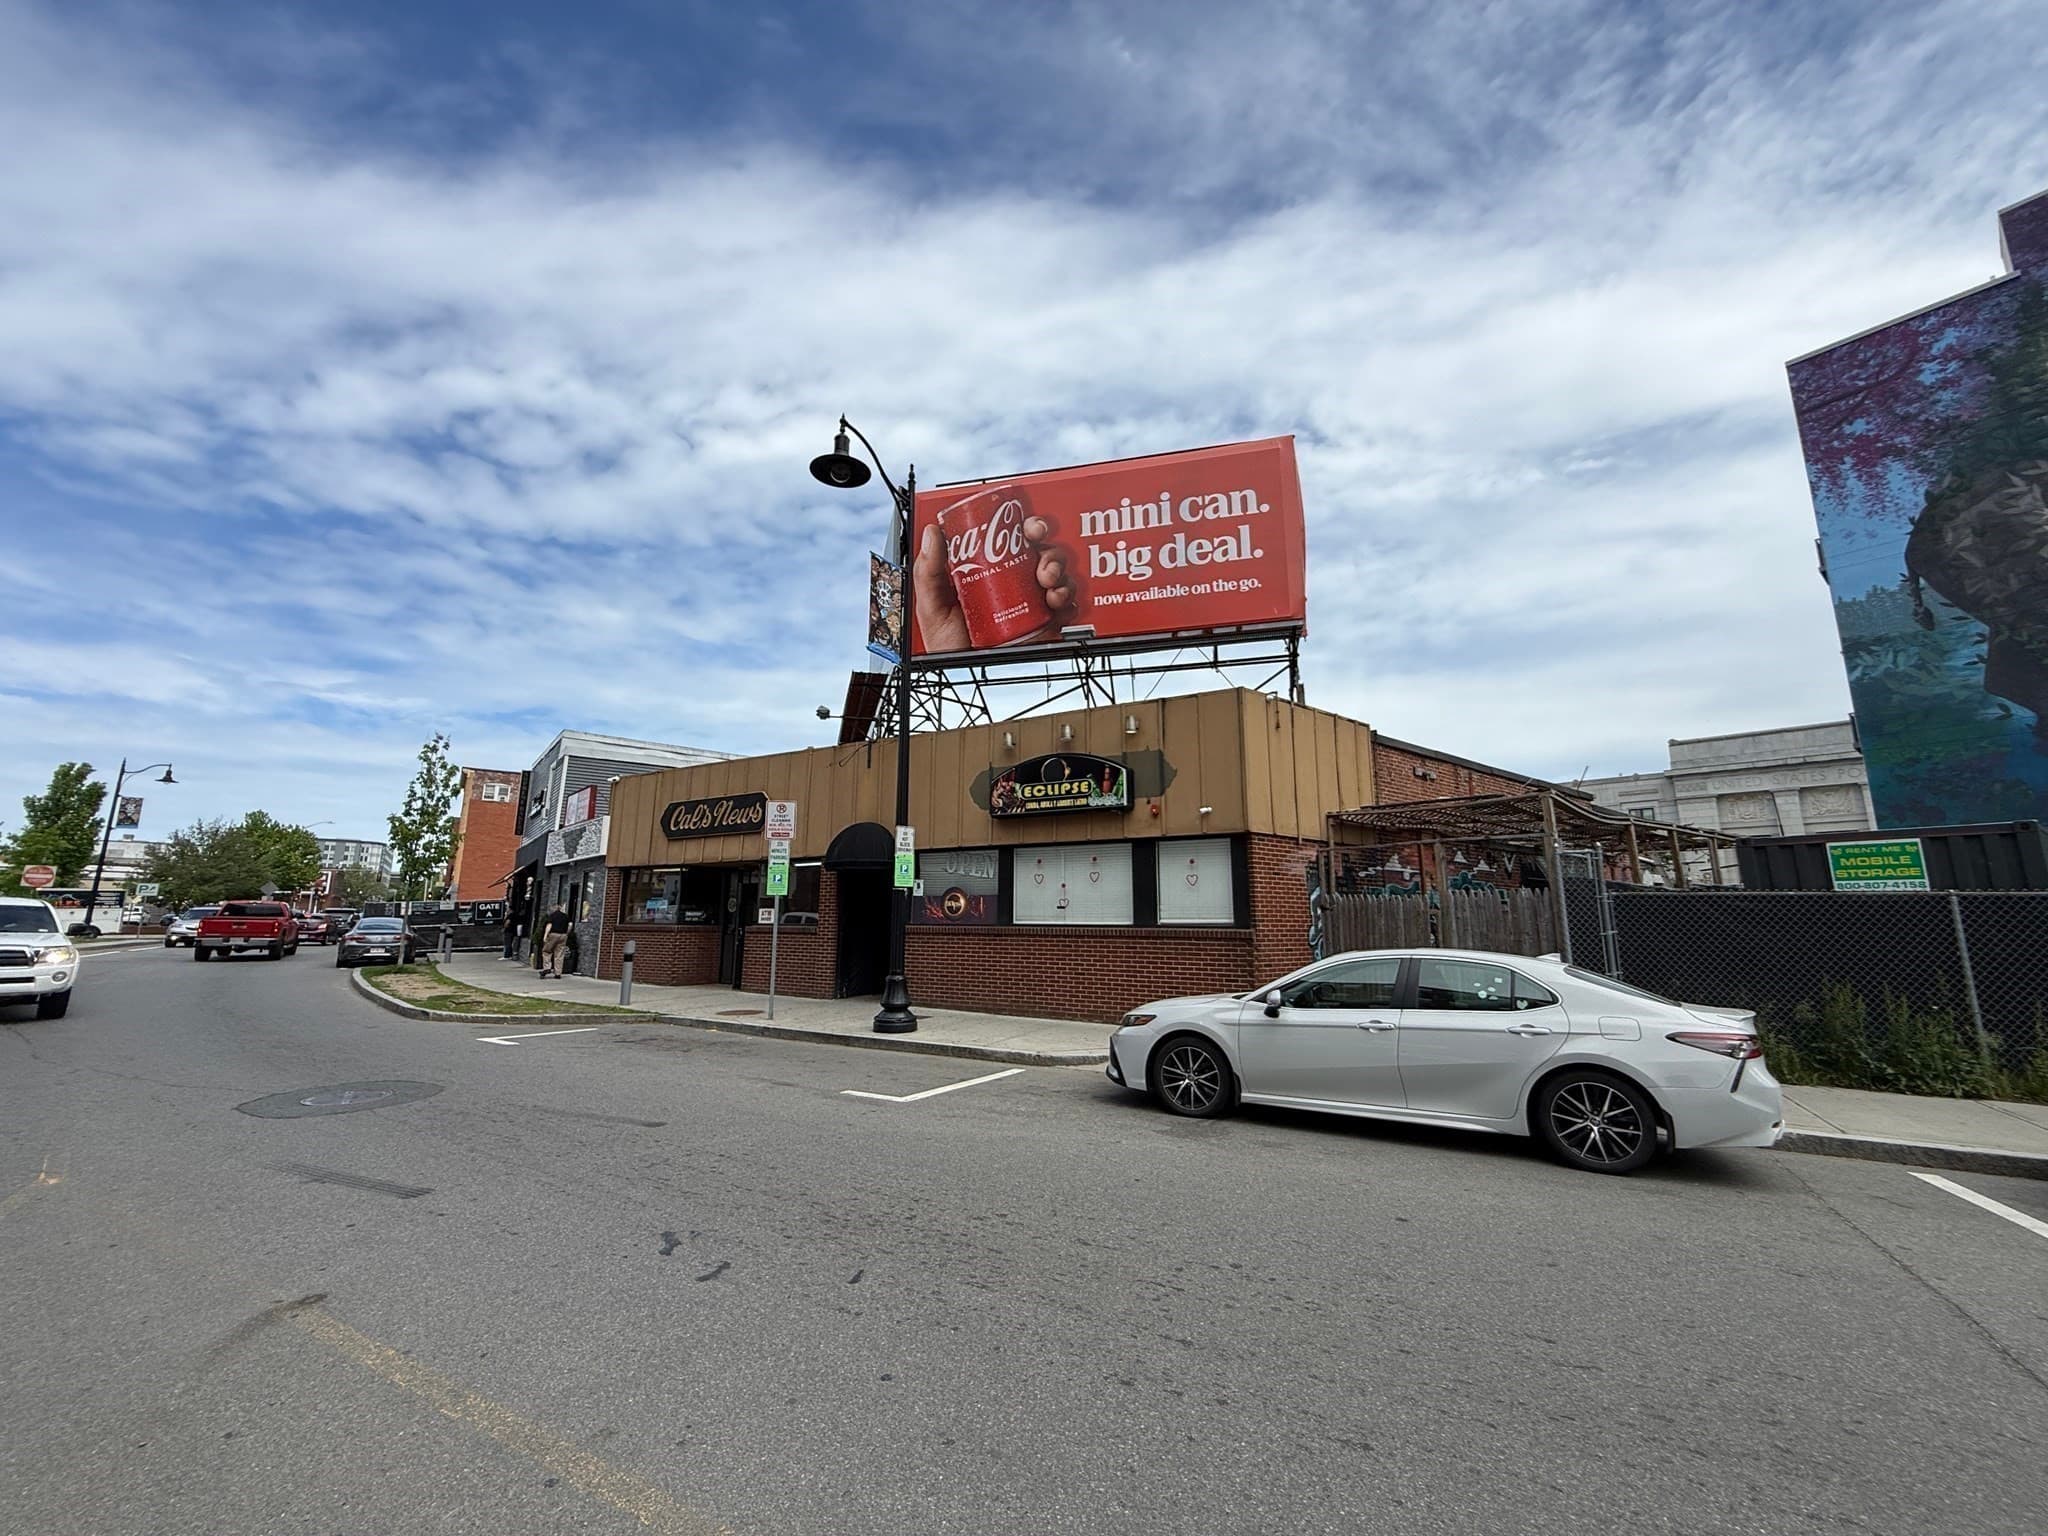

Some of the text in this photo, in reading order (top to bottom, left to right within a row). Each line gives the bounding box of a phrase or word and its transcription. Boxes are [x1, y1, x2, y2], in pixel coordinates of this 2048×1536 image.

[1079, 488, 1270, 538] mini can.
[1088, 524, 1264, 581] big deal.
[961, 553, 1029, 584] ORIGINAL TASTE
[1093, 578, 1262, 606] now available on the go.
[1023, 780, 1089, 798] ECLIPSE
[1712, 776, 1762, 790] UNITED
[1771, 768, 1826, 785] STATES
[670, 800, 763, 831] Cal's News
[1840, 855, 1912, 866] MOBILE
[1845, 846, 1877, 854] RENT
[945, 853, 995, 878] OPEN
[1836, 867, 1922, 878] STORAGE
[138, 884, 149, 894] P
